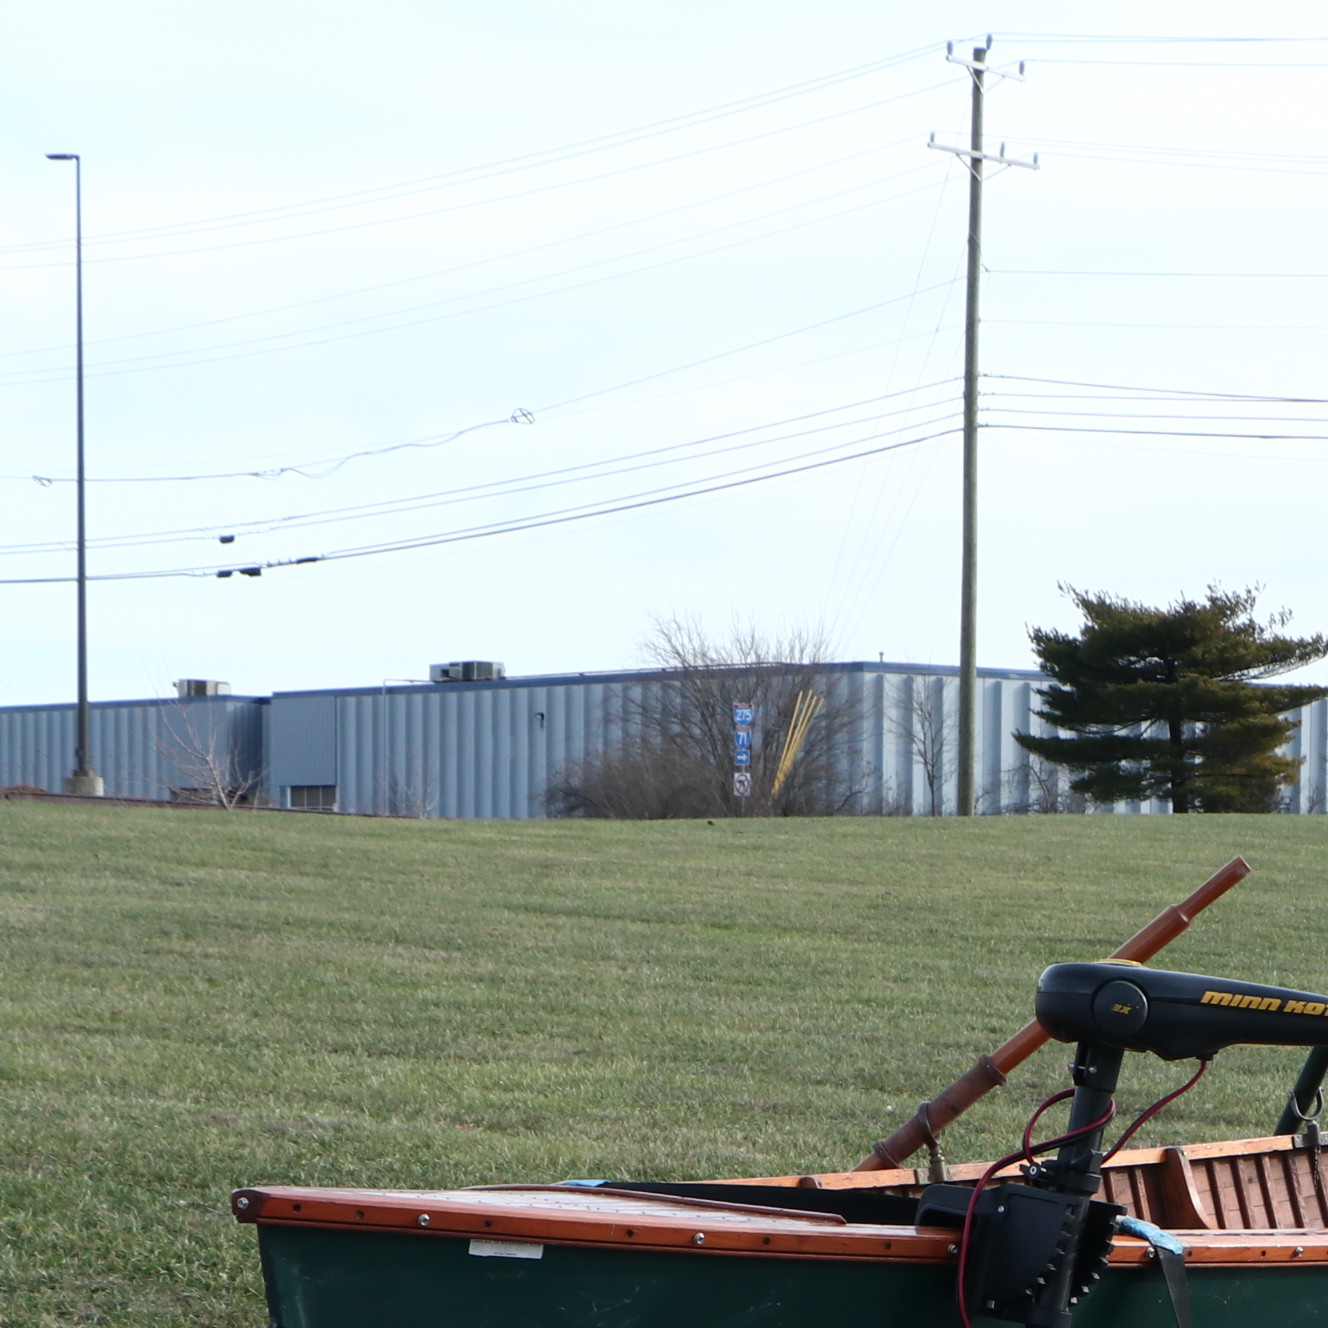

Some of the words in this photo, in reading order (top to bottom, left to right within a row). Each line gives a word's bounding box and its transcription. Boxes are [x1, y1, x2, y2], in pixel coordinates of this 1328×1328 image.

[735, 708, 752, 721] 275
[737, 732, 747, 745] 71
[1200, 990, 1282, 1012] MINN
